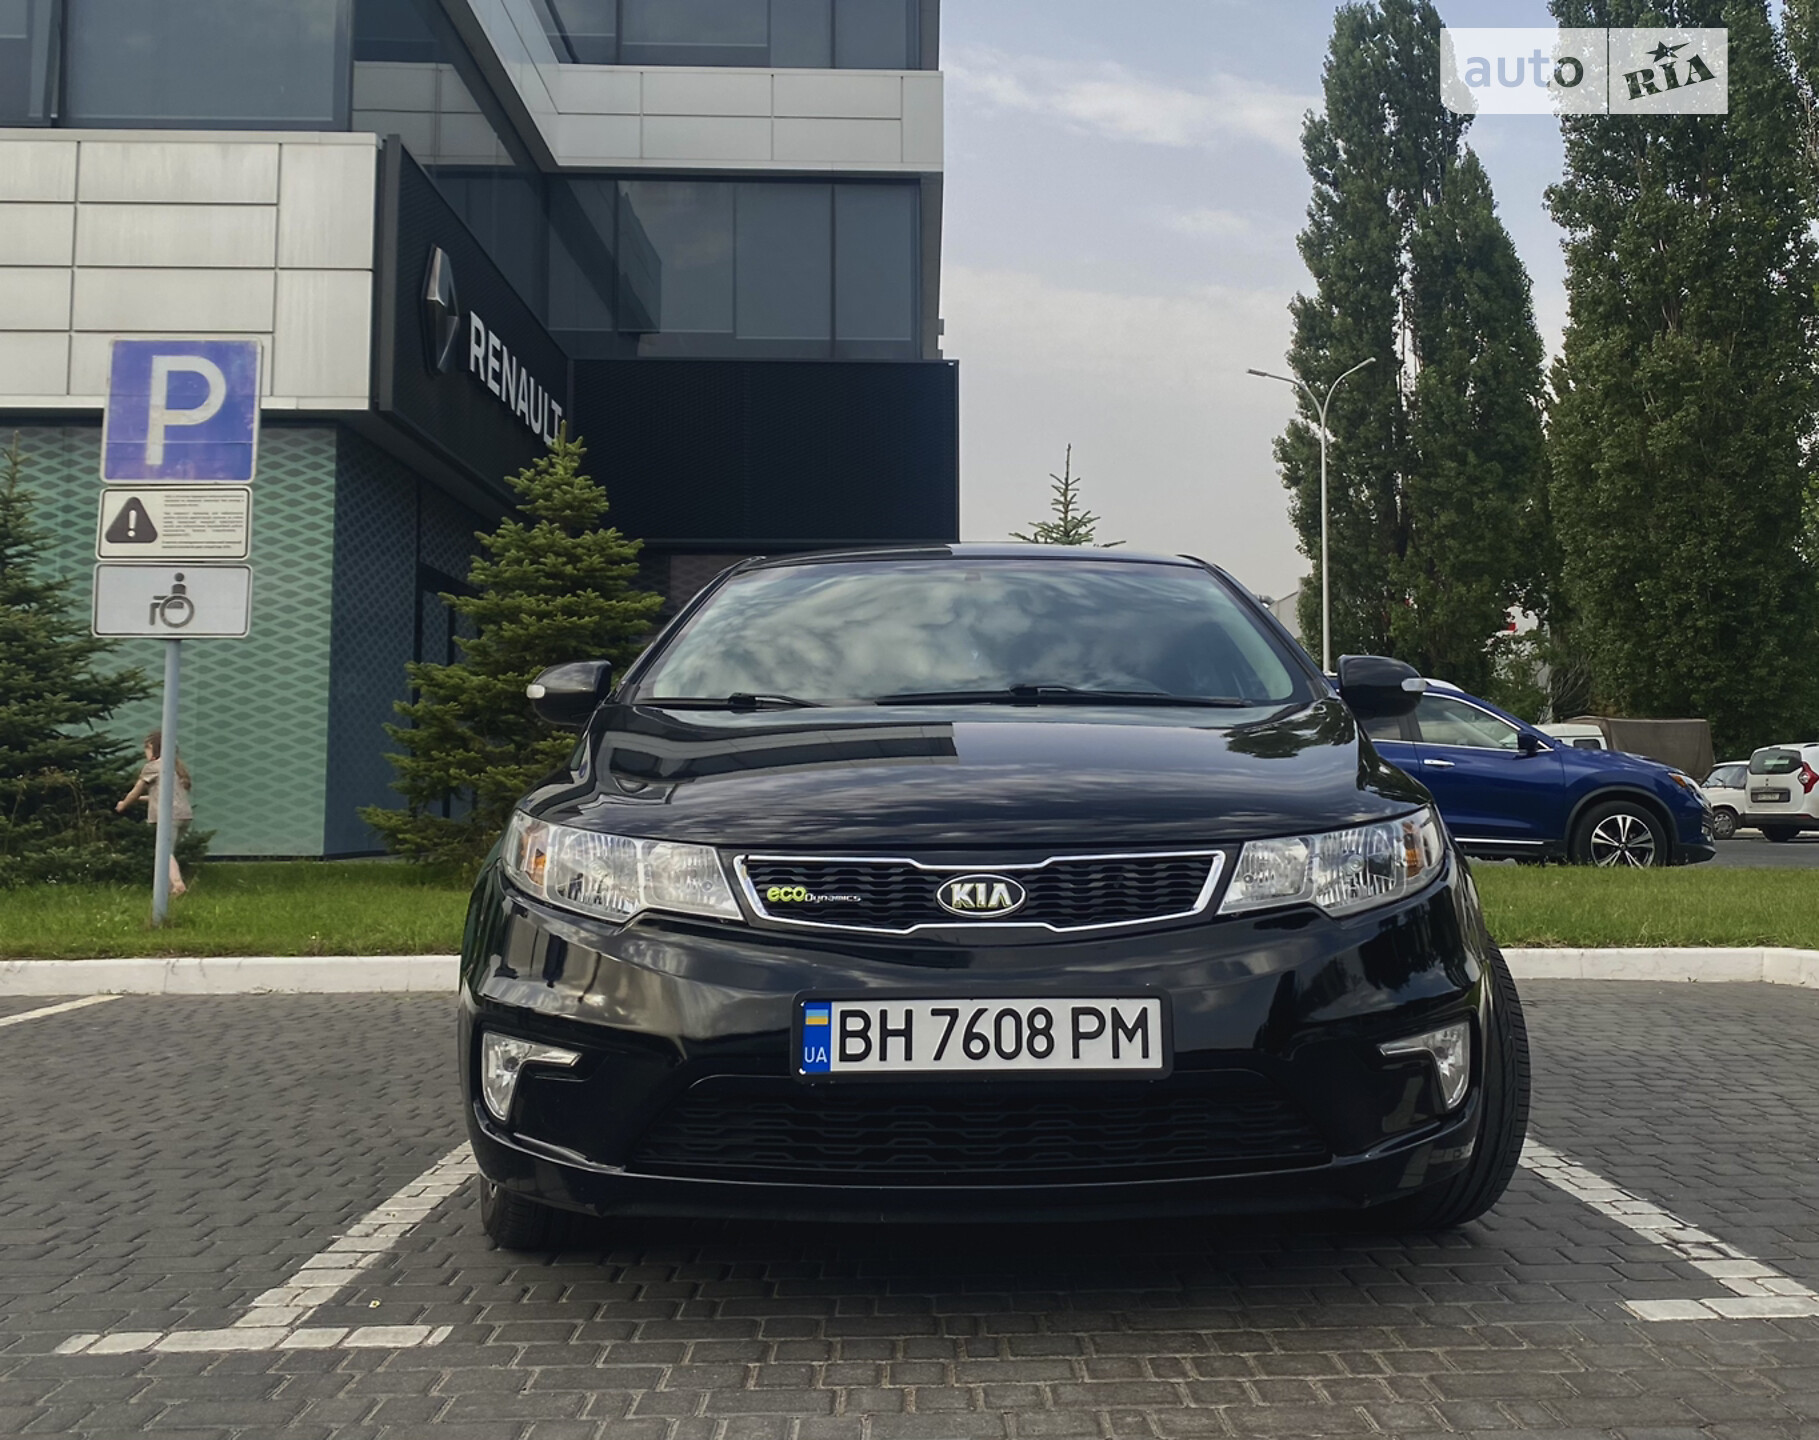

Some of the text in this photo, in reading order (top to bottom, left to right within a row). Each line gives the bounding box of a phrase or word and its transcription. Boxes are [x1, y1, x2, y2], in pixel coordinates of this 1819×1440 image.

[469, 310, 562, 447] RENAULT
[145, 355, 227, 465] P
[950, 883, 1013, 908] KIA
[804, 1046, 828, 1064] UA
[838, 1007, 1149, 1062] BH 7608 PM
